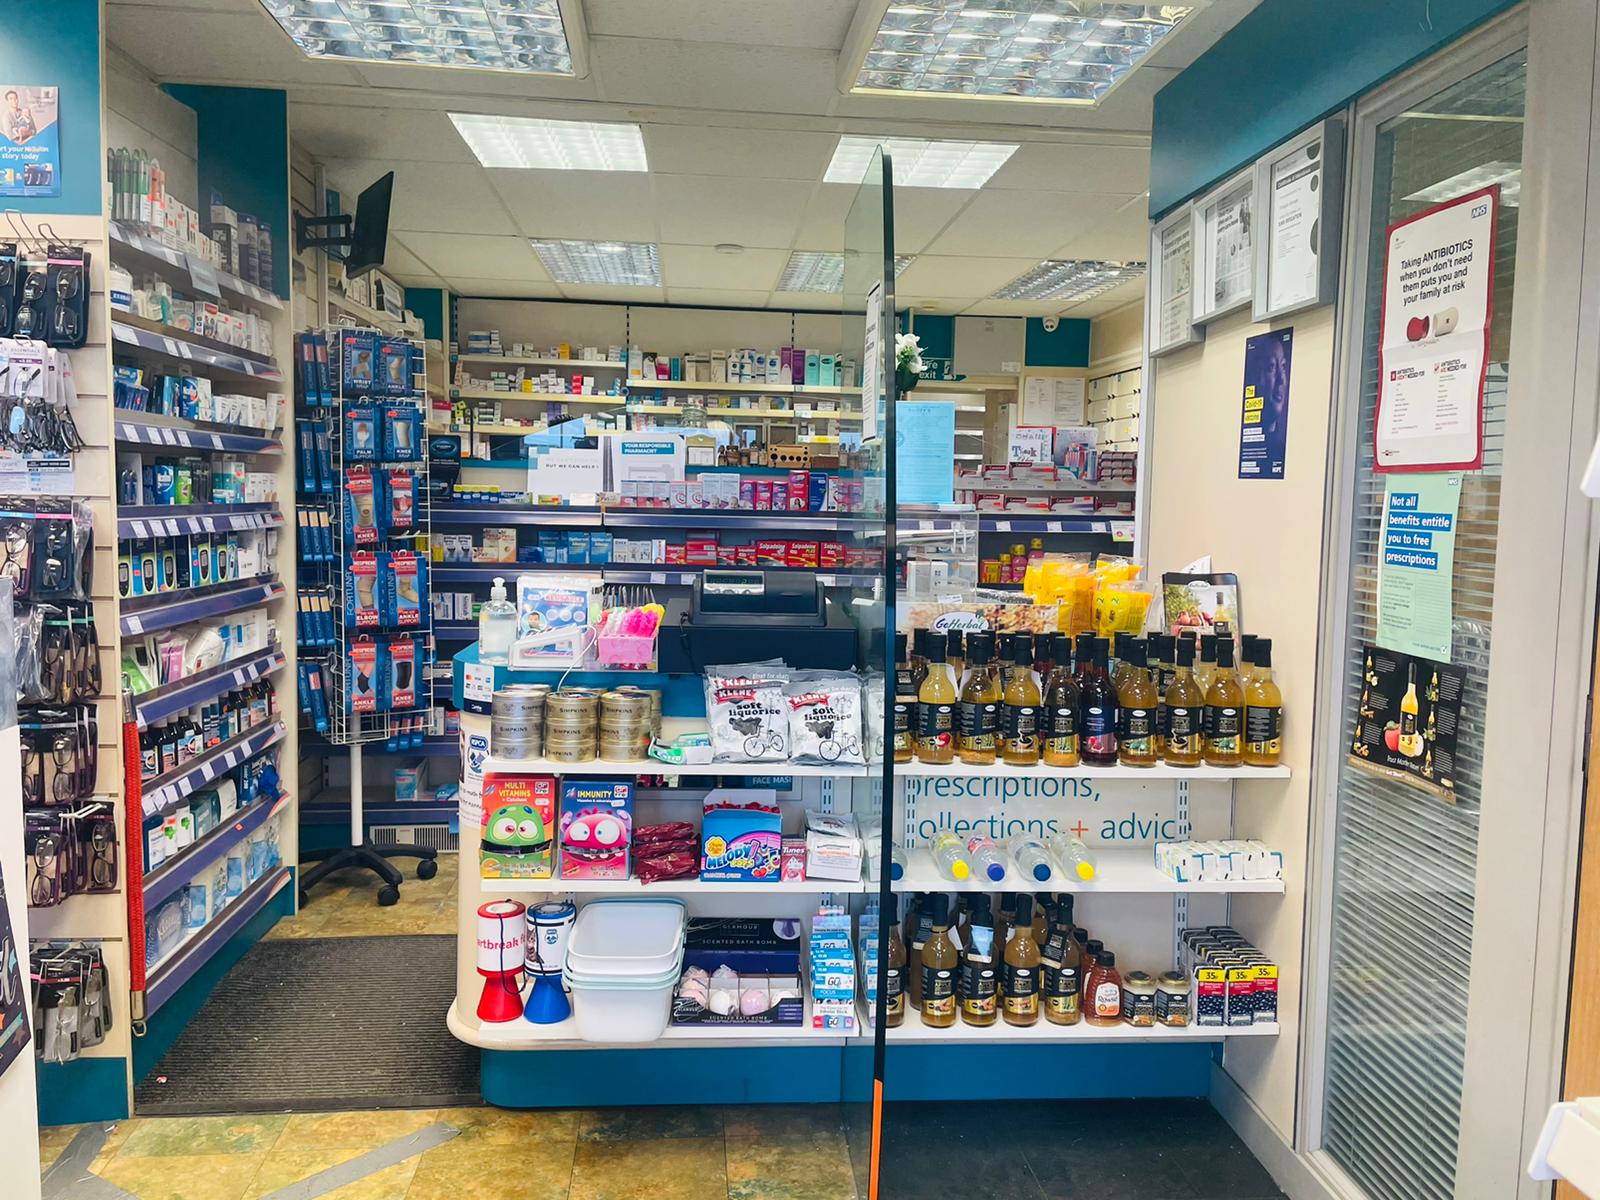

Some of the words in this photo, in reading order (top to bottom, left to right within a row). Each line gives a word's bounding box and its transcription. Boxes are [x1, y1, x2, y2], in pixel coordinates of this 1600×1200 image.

[2, 153, 20, 161] story
[21, 153, 40, 161] today
[1472, 204, 1487, 218] NHS
[1401, 257, 1422, 270] Taking
[1422, 238, 1473, 263] ANTIBIOTICS
[1400, 269, 1418, 282] when
[1418, 266, 1432, 279] you
[1432, 258, 1453, 272] don't
[1453, 252, 1473, 266] need
[1402, 280, 1420, 293] them
[1420, 275, 1437, 289] puts
[1438, 272, 1453, 286] you
[1453, 266, 1468, 279] and
[1403, 294, 1419, 306] your
[1419, 287, 1442, 301] family
[1442, 284, 1451, 294] at
[1451, 280, 1466, 293] risk
[919, 369, 937, 379] exit
[1246, 388, 1254, 396] The
[1245, 399, 1263, 409] Covid-19
[1391, 496, 1405, 506] Not
[1405, 495, 1416, 507] all
[1389, 514, 1420, 527] benefits
[1421, 516, 1450, 528] entitle
[1387, 533, 1401, 545] you
[1403, 534, 1412, 545] to
[1413, 533, 1430, 546] free
[1386, 552, 1436, 566] prescriptions
[345, 570, 354, 616] FORTUNA
[935, 617, 983, 630] GeHerbal
[718, 690, 751, 698] KLENE
[794, 694, 826, 704] KLENE
[736, 702, 762, 710] soft
[728, 709, 781, 718] liquorice
[812, 707, 835, 716] soft
[804, 713, 852, 722] liquorice
[471, 738, 486, 747] RSPCA
[1387, 755, 1397, 763] Trust
[498, 789, 531, 797] VITAMINS
[918, 812, 1058, 840] ollections
[1100, 812, 1192, 840] advic
[783, 846, 805, 854] Tunes
[706, 845, 752, 869] MELODY
[828, 977, 841, 986] GO
[828, 1017, 839, 1026] GO
